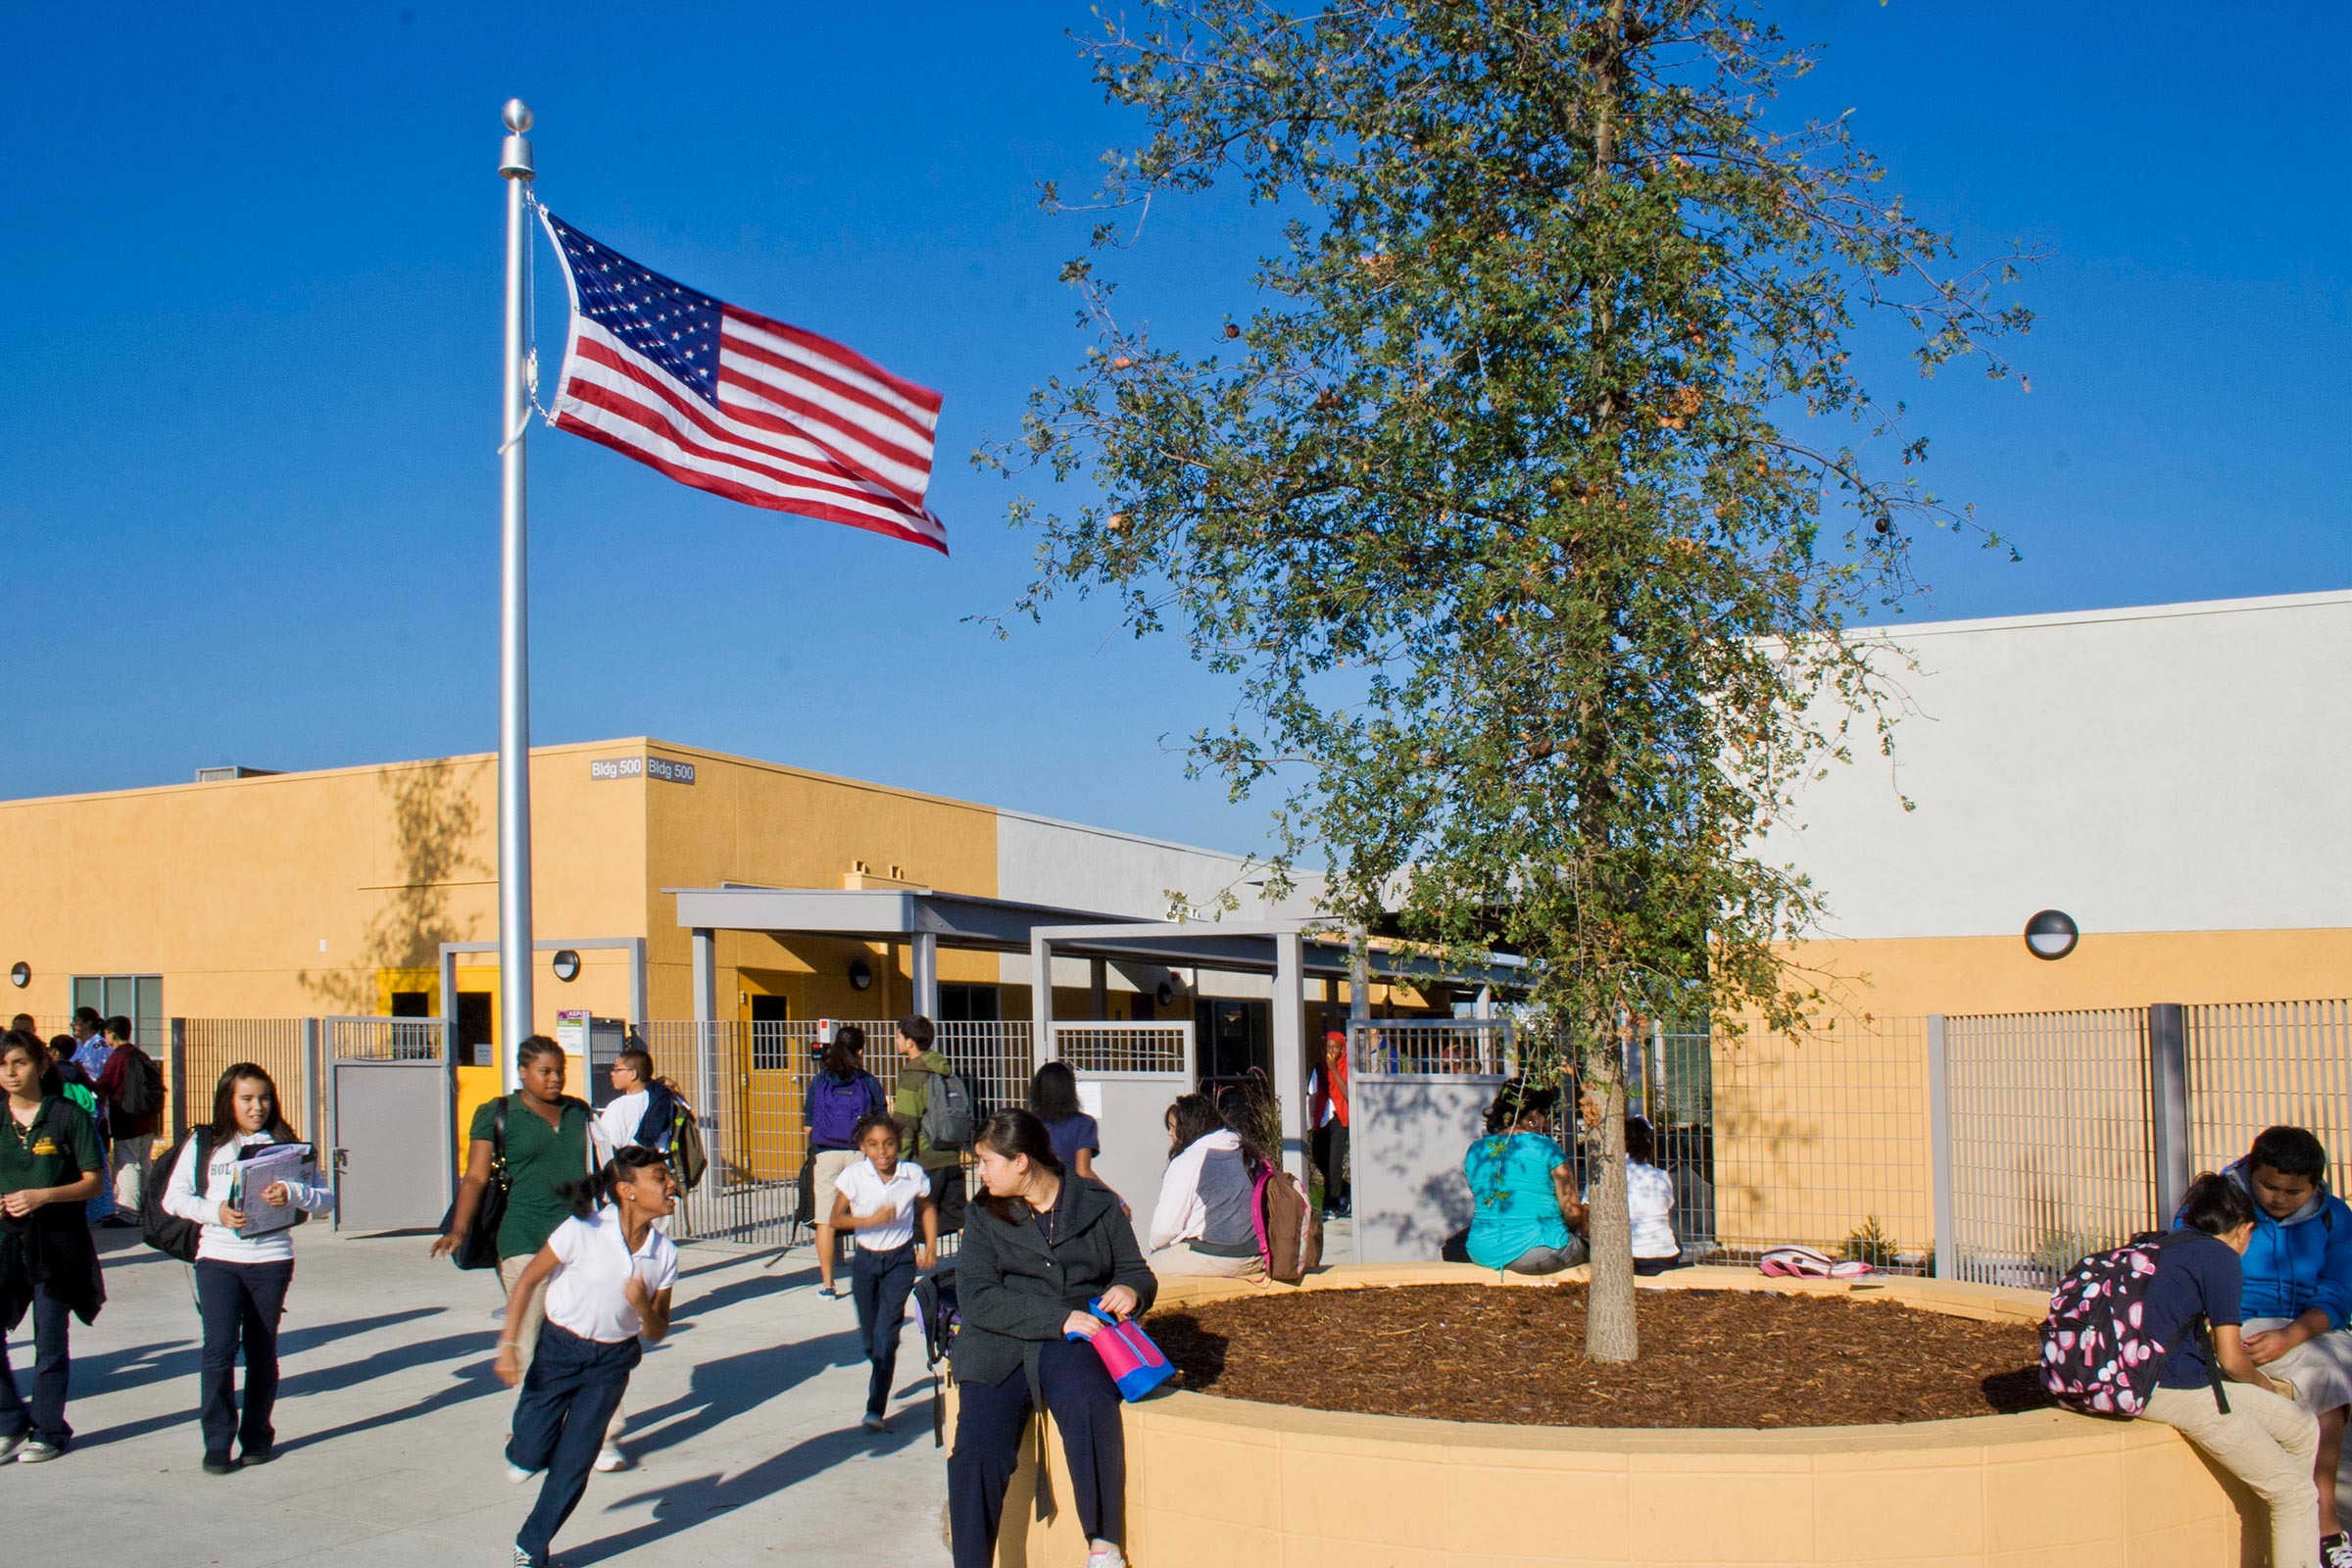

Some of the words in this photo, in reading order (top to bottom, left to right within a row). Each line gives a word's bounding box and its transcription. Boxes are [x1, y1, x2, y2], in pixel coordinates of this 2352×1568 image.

[592, 761, 617, 778] Bldg
[619, 759, 642, 774] 500
[648, 759, 672, 779] Bldg
[674, 763, 694, 780] 500
